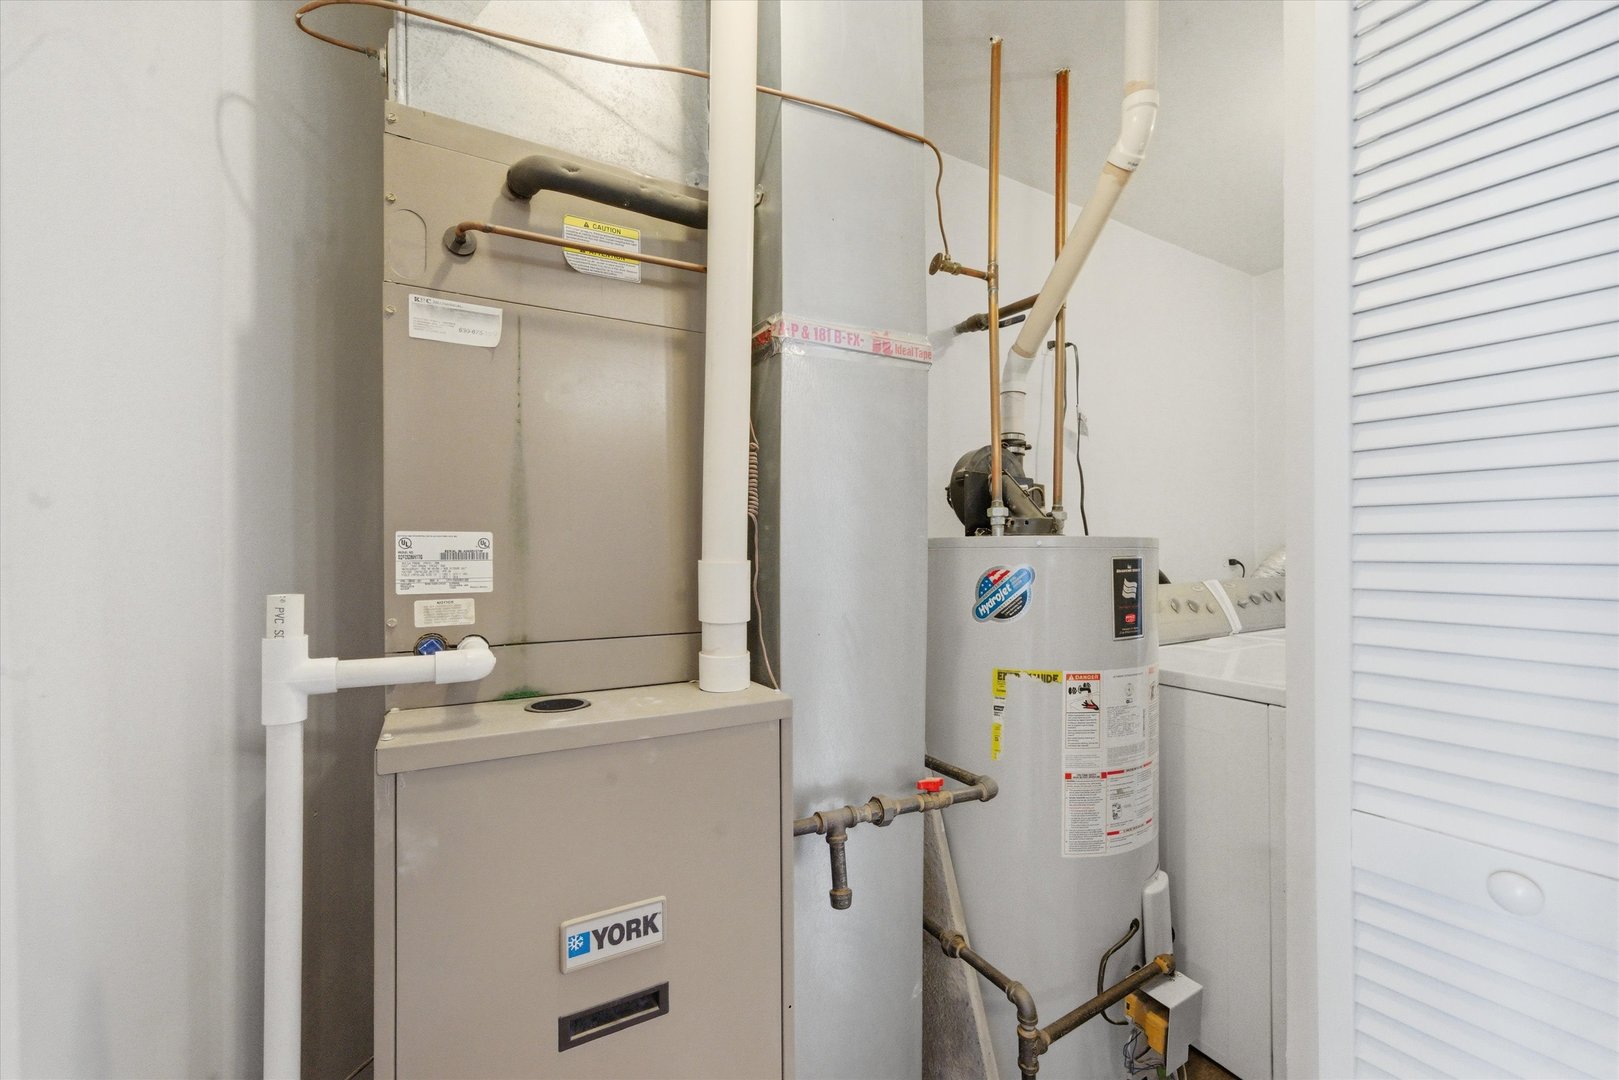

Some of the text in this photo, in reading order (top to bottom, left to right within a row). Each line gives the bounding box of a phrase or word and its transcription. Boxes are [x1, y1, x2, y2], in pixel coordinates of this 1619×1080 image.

[592, 223, 622, 235] CAUTION
[274, 607, 285, 624] PVC
[592, 912, 660, 950] YORK
